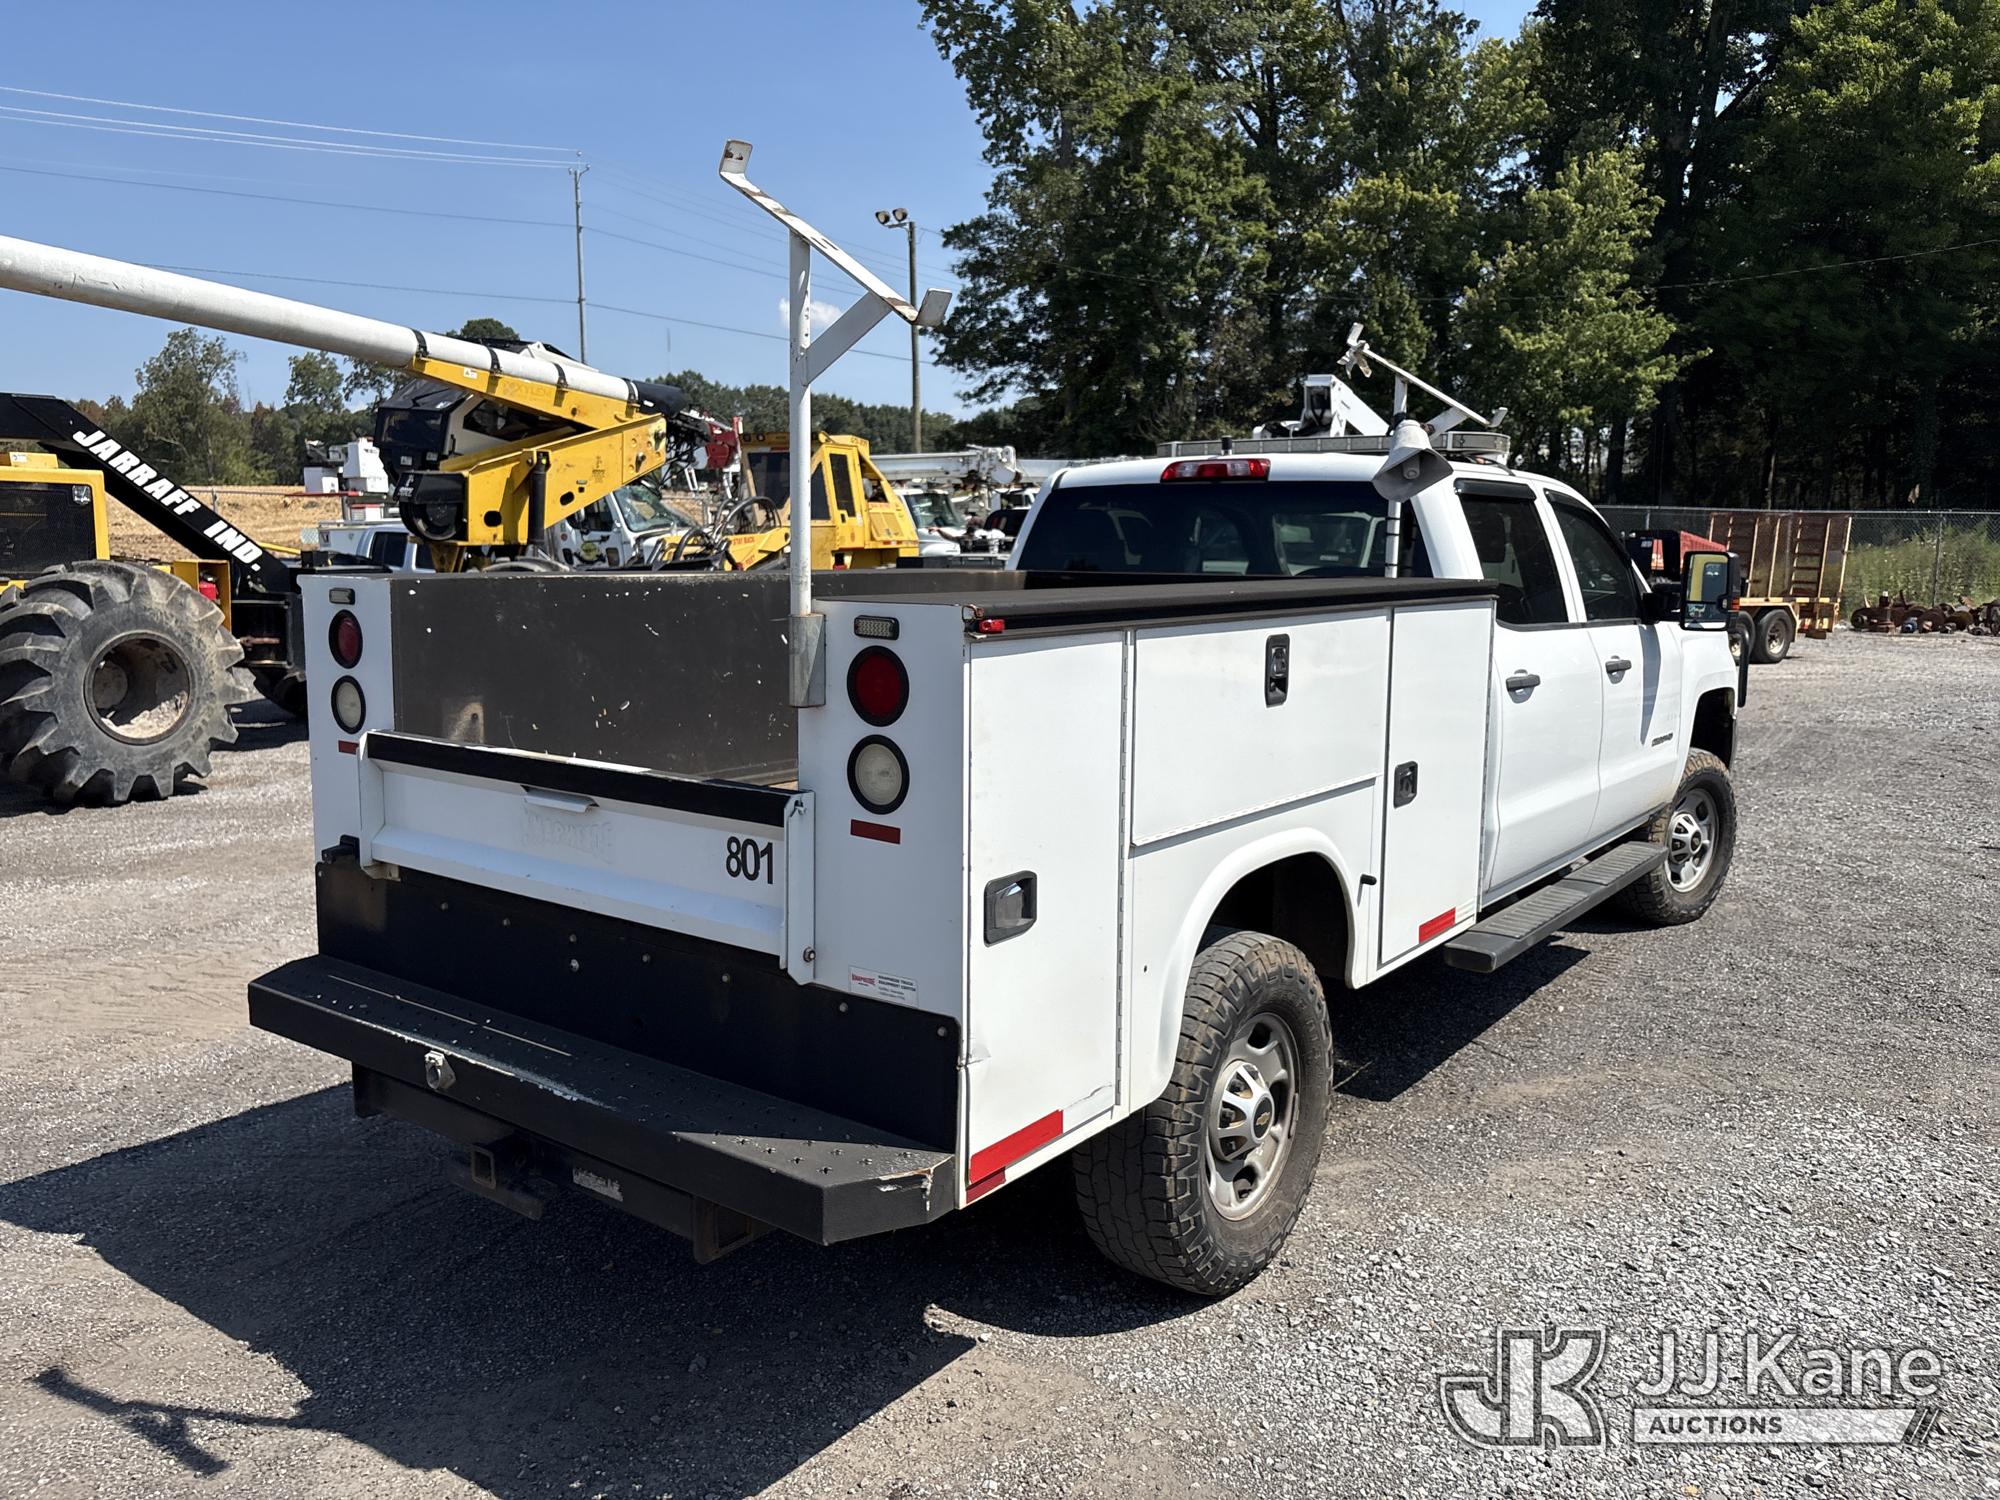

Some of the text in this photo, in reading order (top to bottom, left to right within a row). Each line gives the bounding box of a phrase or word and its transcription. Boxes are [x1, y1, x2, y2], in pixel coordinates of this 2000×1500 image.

[73, 430, 263, 571] JARRAFF IND.
[726, 836, 773, 885] 801
